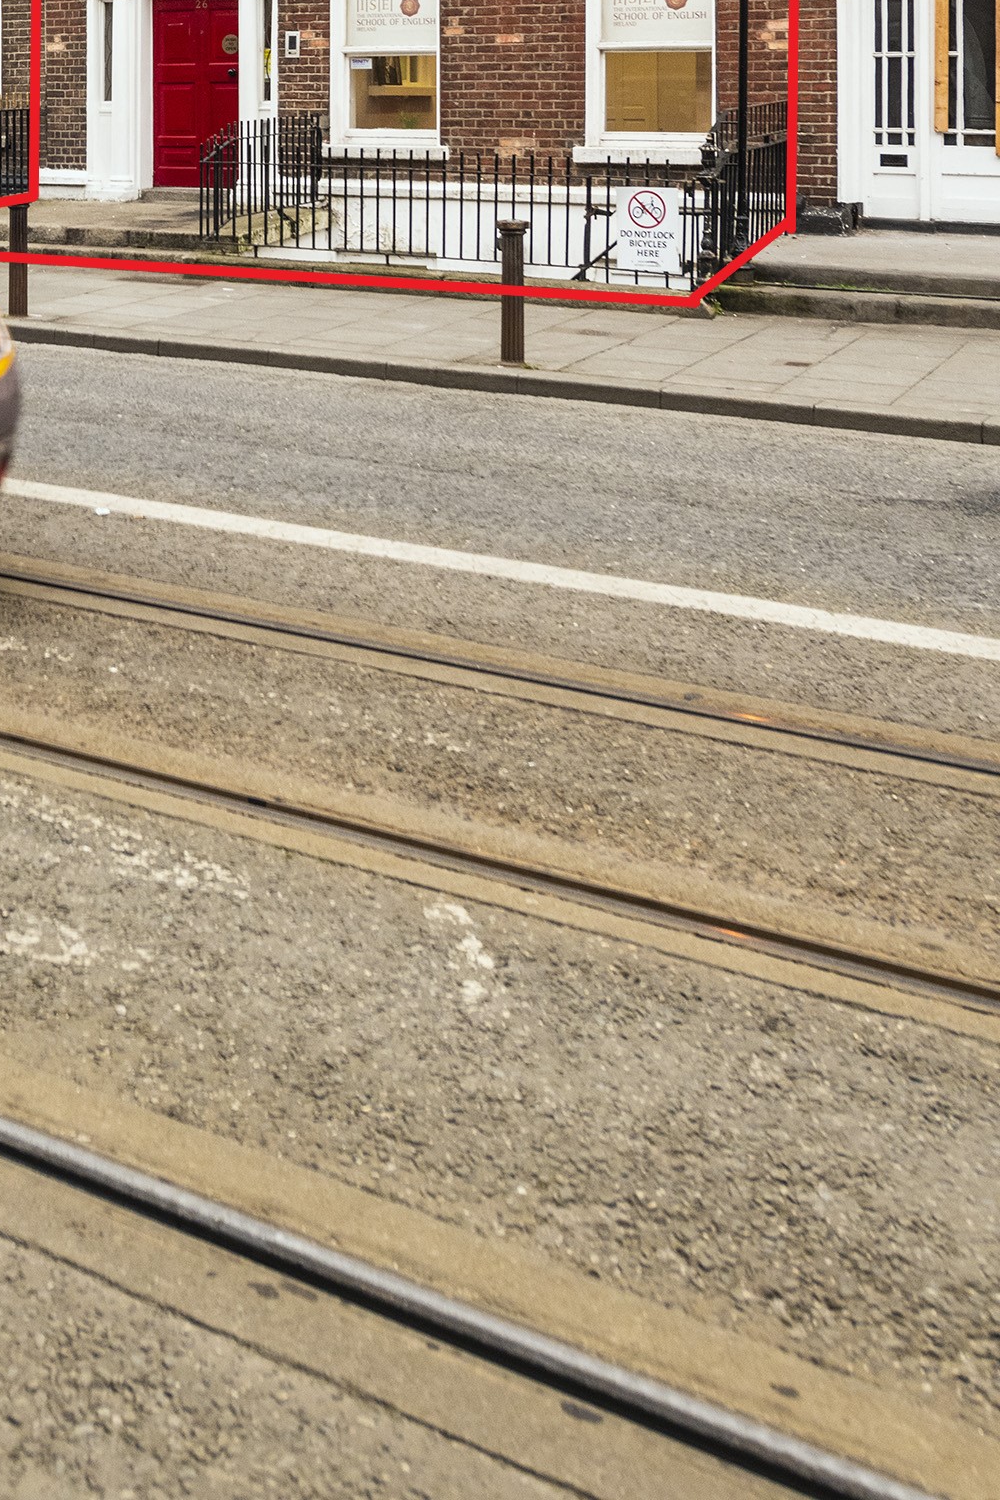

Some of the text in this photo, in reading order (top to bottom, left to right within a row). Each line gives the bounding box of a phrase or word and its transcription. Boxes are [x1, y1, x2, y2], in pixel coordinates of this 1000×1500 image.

[195, 0, 208, 9] 26
[613, 10, 707, 21] SCHOOL OF ENGLISH
[356, 16, 436, 27] SCHOOL OF ENGLISH
[620, 229, 675, 240] DO NOT LOCK
[629, 240, 668, 249] BICYCLES
[637, 249, 660, 258] HERE
